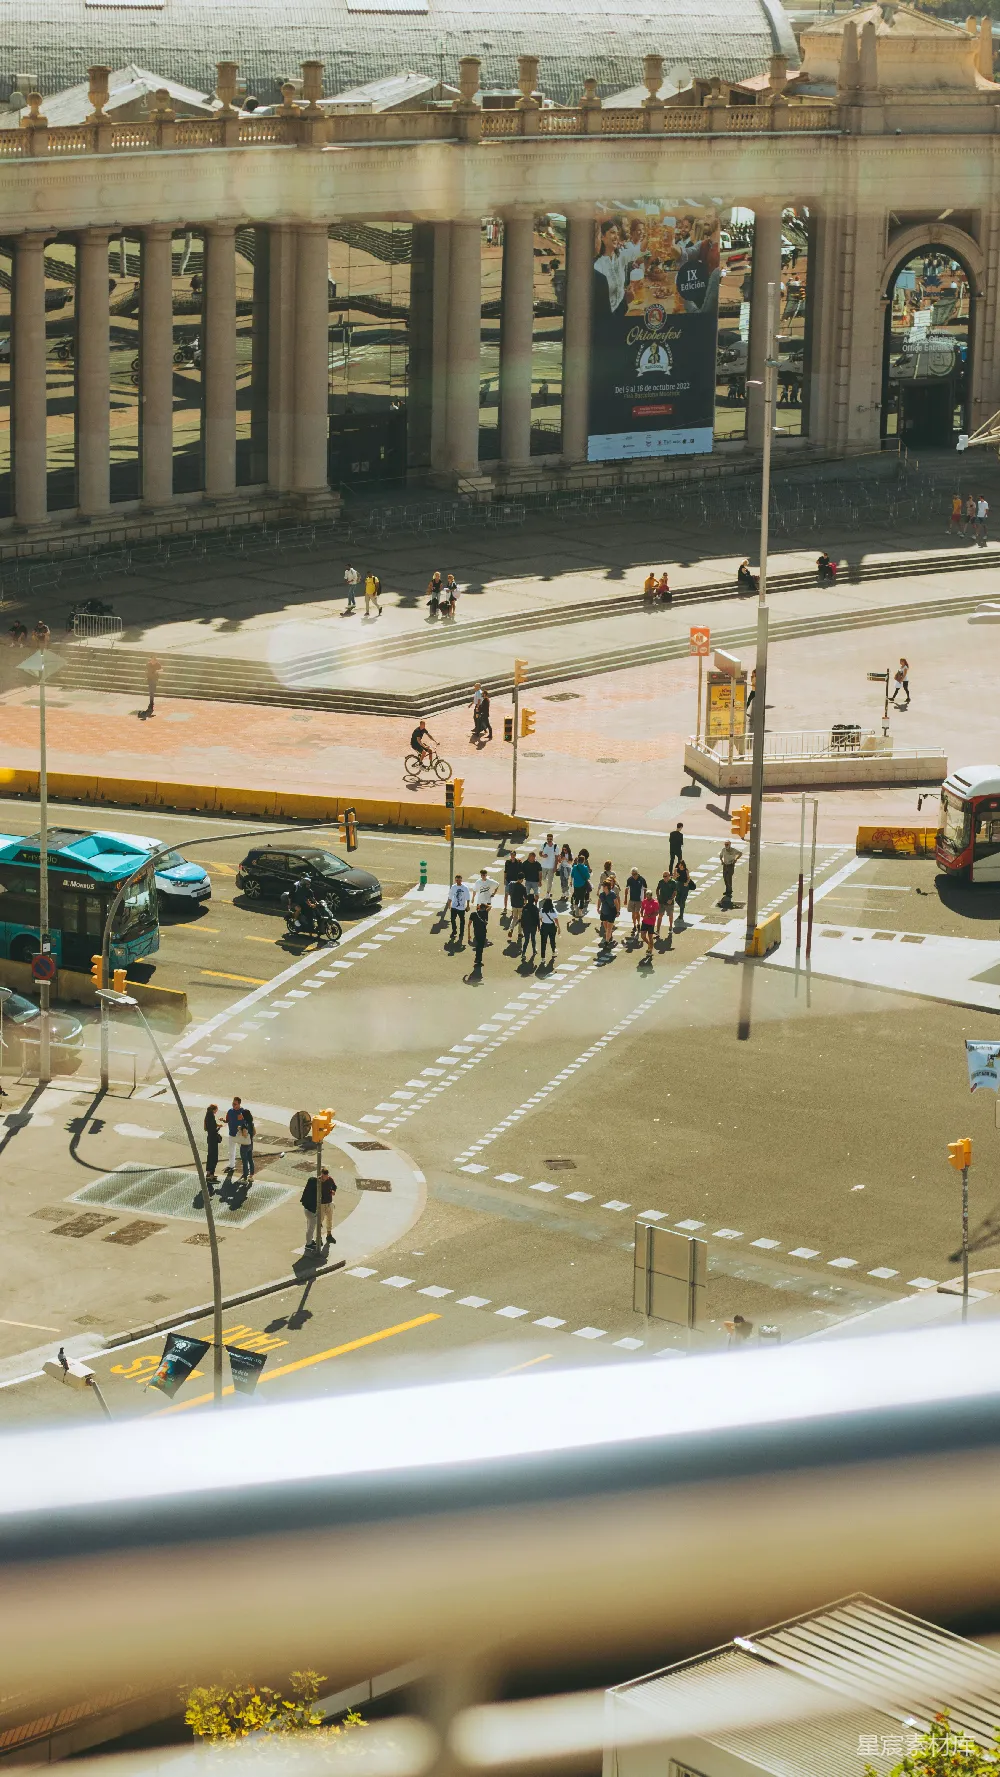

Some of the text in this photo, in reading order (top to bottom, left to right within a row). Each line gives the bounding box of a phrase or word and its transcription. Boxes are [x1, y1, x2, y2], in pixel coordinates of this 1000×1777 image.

[687, 269, 698, 281] IX
[681, 281, 705, 291] Edición
[626, 325, 682, 345] Oktoberfest
[615, 386, 625, 394] Del
[644, 384, 652, 392] de
[652, 382, 676, 391] octubre
[676, 382, 690, 390] 2022
